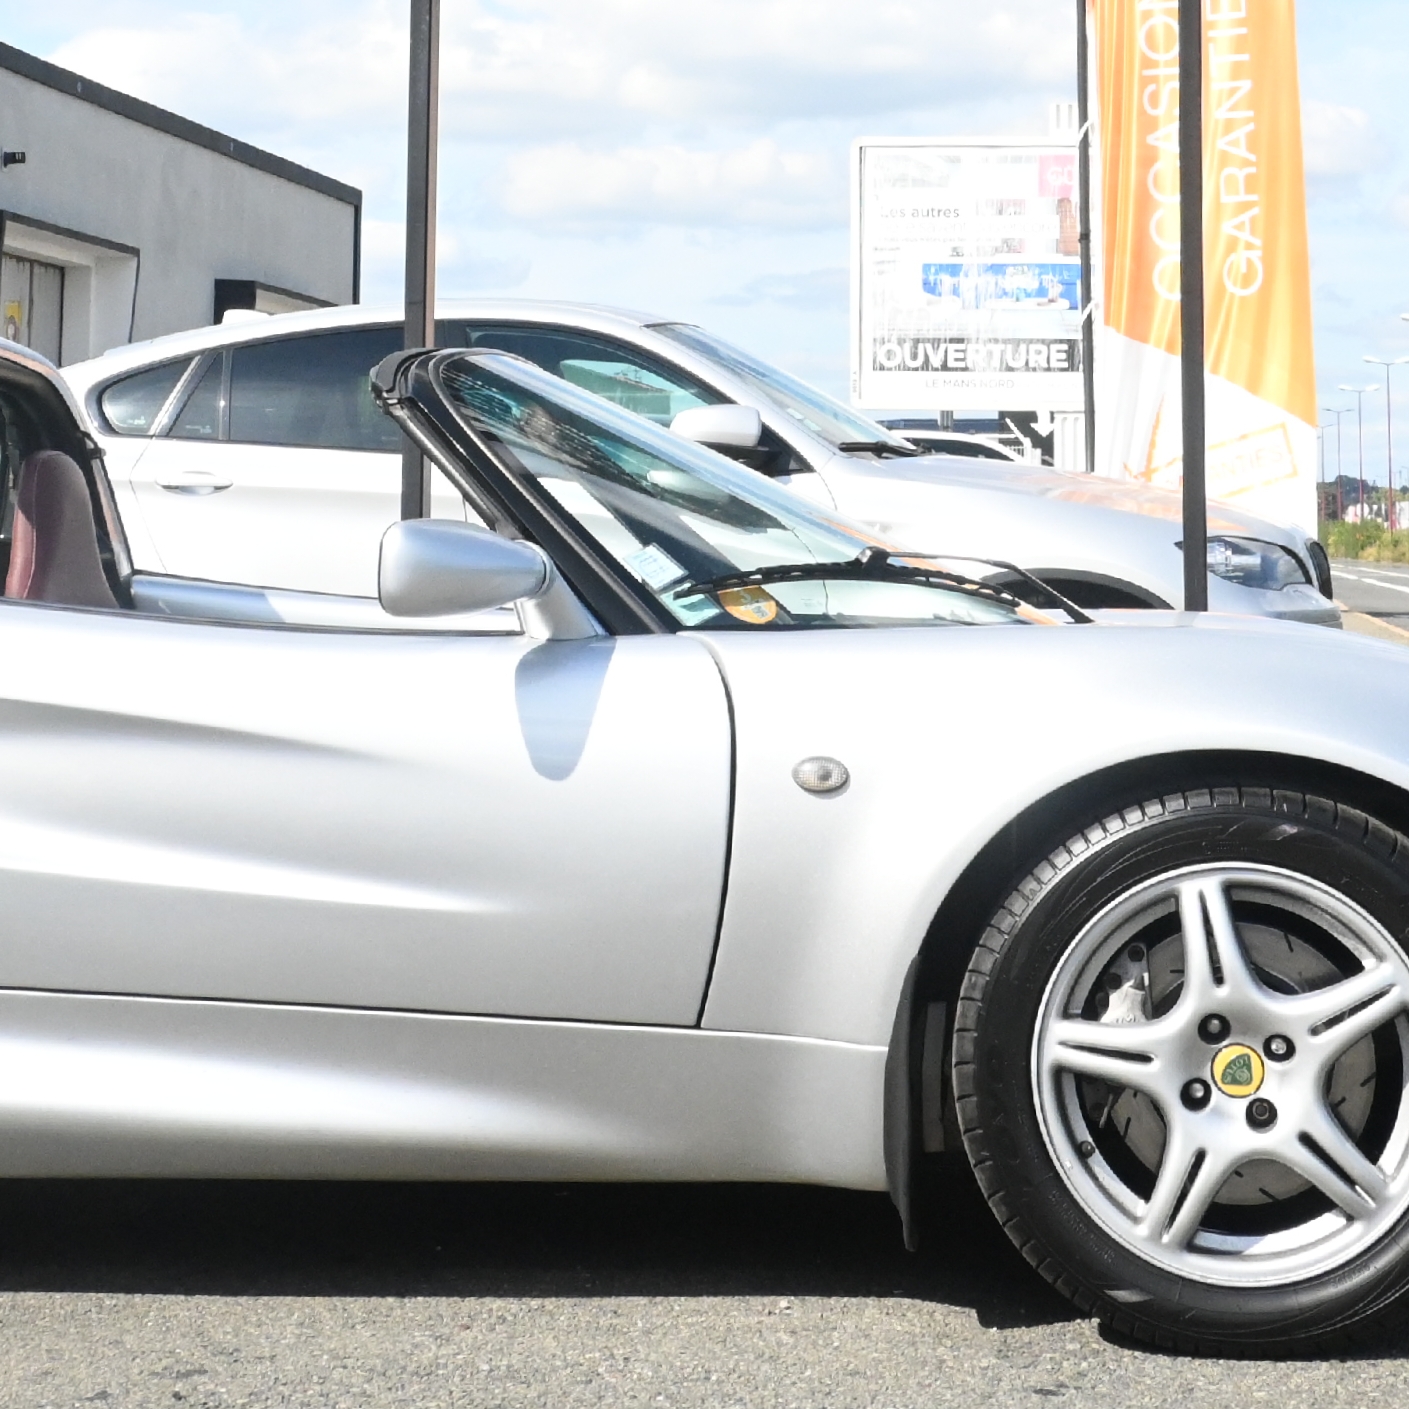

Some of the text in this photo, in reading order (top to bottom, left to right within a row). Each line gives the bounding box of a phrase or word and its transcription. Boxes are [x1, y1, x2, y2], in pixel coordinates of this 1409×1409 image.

[911, 207, 960, 218] autres
[877, 342, 1069, 368] OUVERTURE
[925, 378, 939, 389] LE
[943, 378, 977, 389] MANS
[979, 378, 1015, 389] NORD
